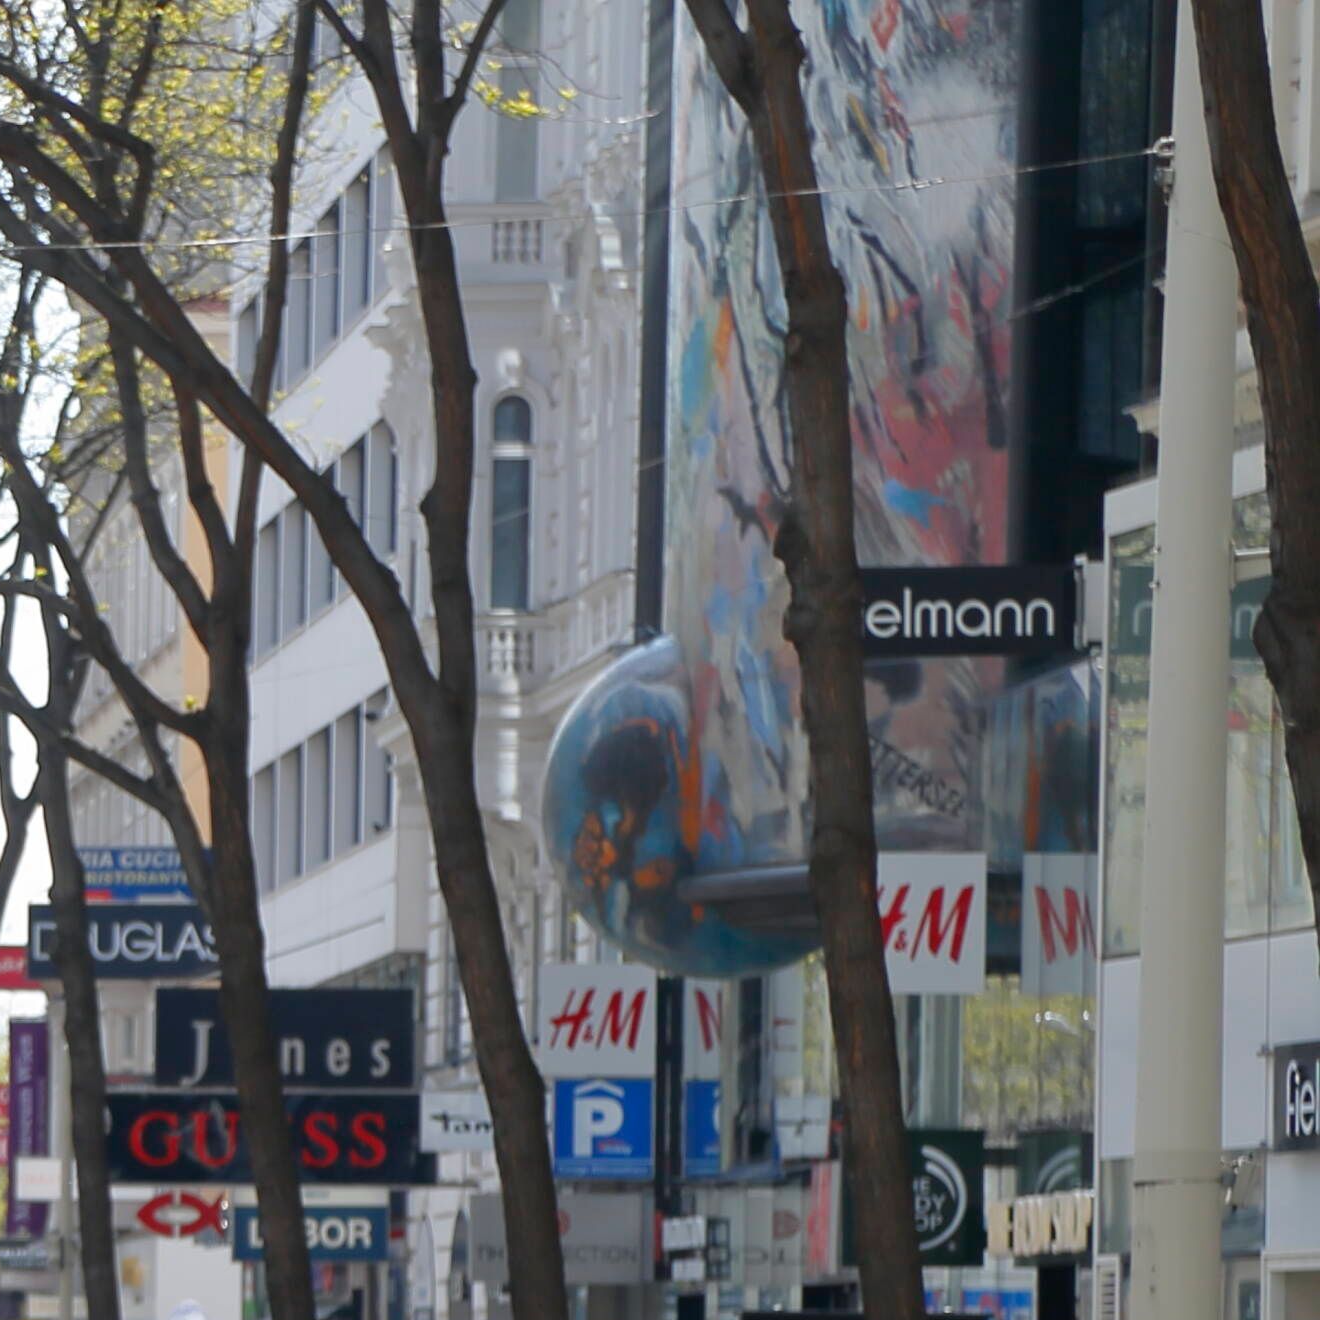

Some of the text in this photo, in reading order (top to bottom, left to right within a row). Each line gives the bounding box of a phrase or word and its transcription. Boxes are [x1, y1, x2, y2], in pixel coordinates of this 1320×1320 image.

[861, 586, 1056, 638] elmann
[30, 920, 221, 962] DUGLAS
[550, 987, 647, 1051] H&M
[178, 1020, 392, 1088] Jnes
[128, 1110, 388, 1168] GUSS
[573, 1096, 626, 1158] P
[248, 1219, 373, 1250] LBOR
